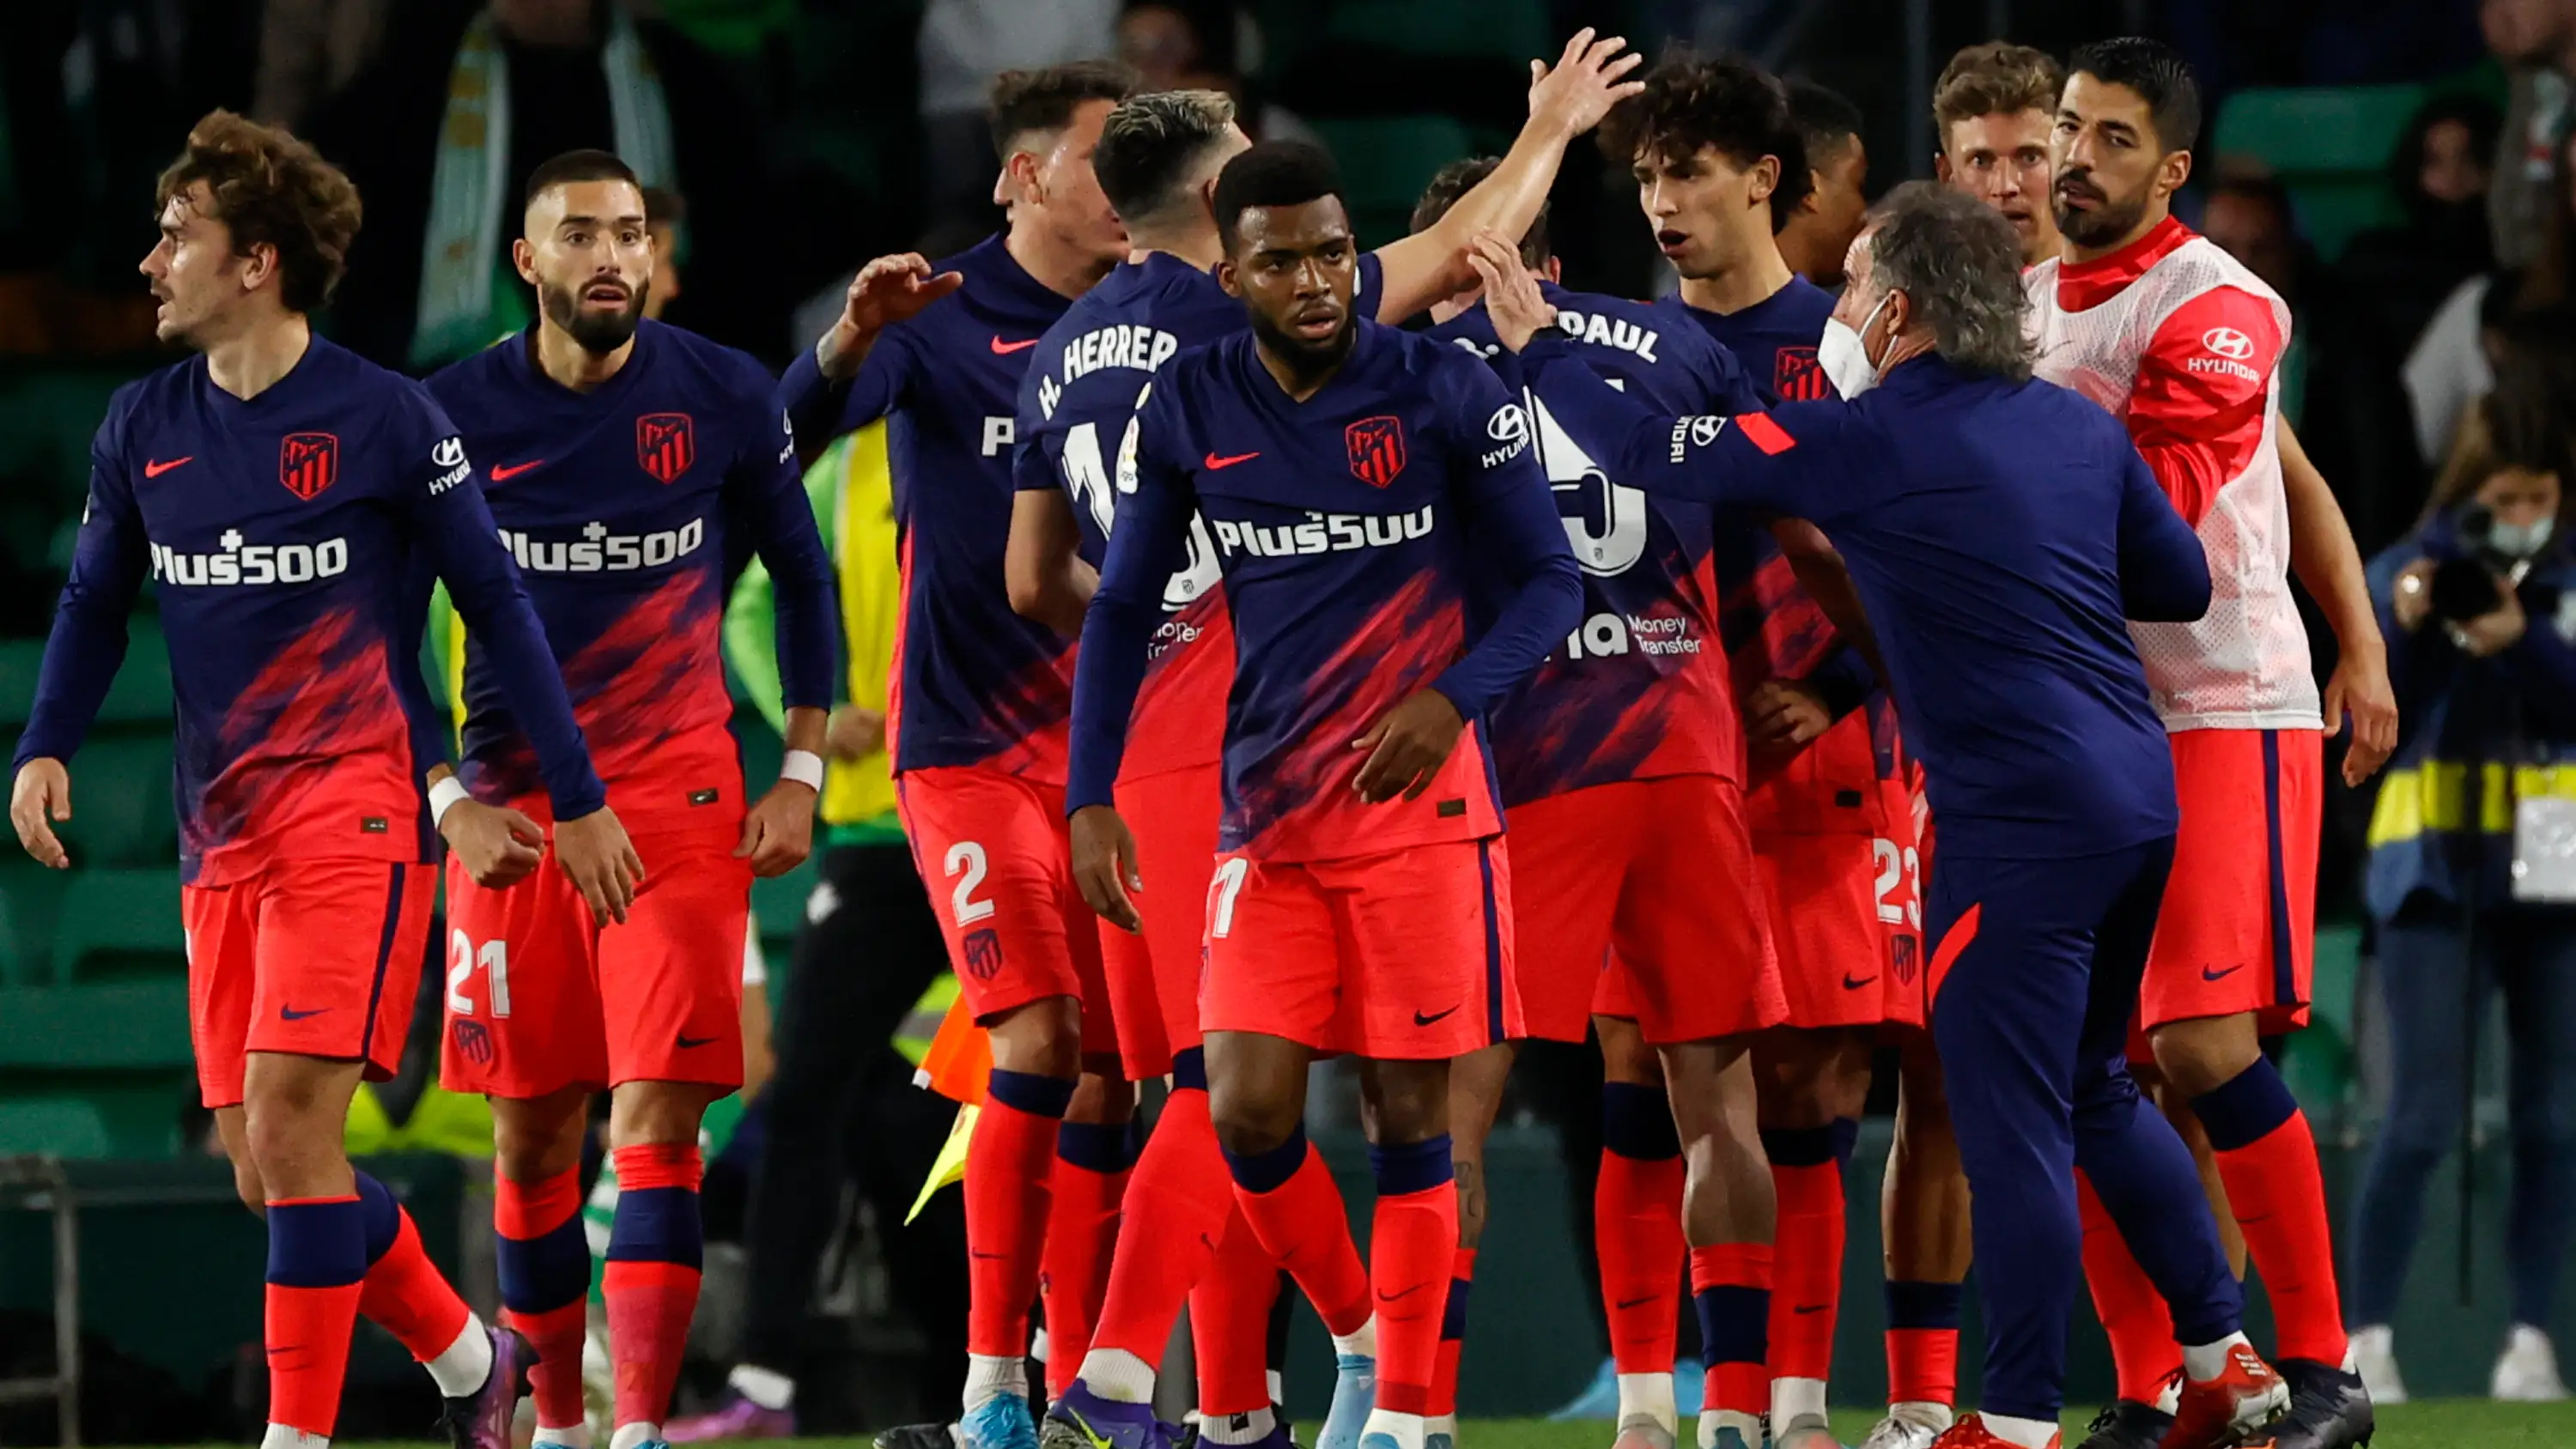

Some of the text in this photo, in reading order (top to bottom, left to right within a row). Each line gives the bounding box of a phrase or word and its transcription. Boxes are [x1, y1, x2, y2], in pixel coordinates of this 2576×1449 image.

[1558, 310, 1658, 364] PAUL
[2187, 357, 2260, 387] HYUNDAI
[149, 529, 348, 585] Plus500
[1626, 614, 1686, 635] Money
[1634, 634, 1702, 655] Transfer
[945, 841, 995, 929] 2
[1873, 838, 1922, 932] 23
[448, 928, 511, 1019] 21
